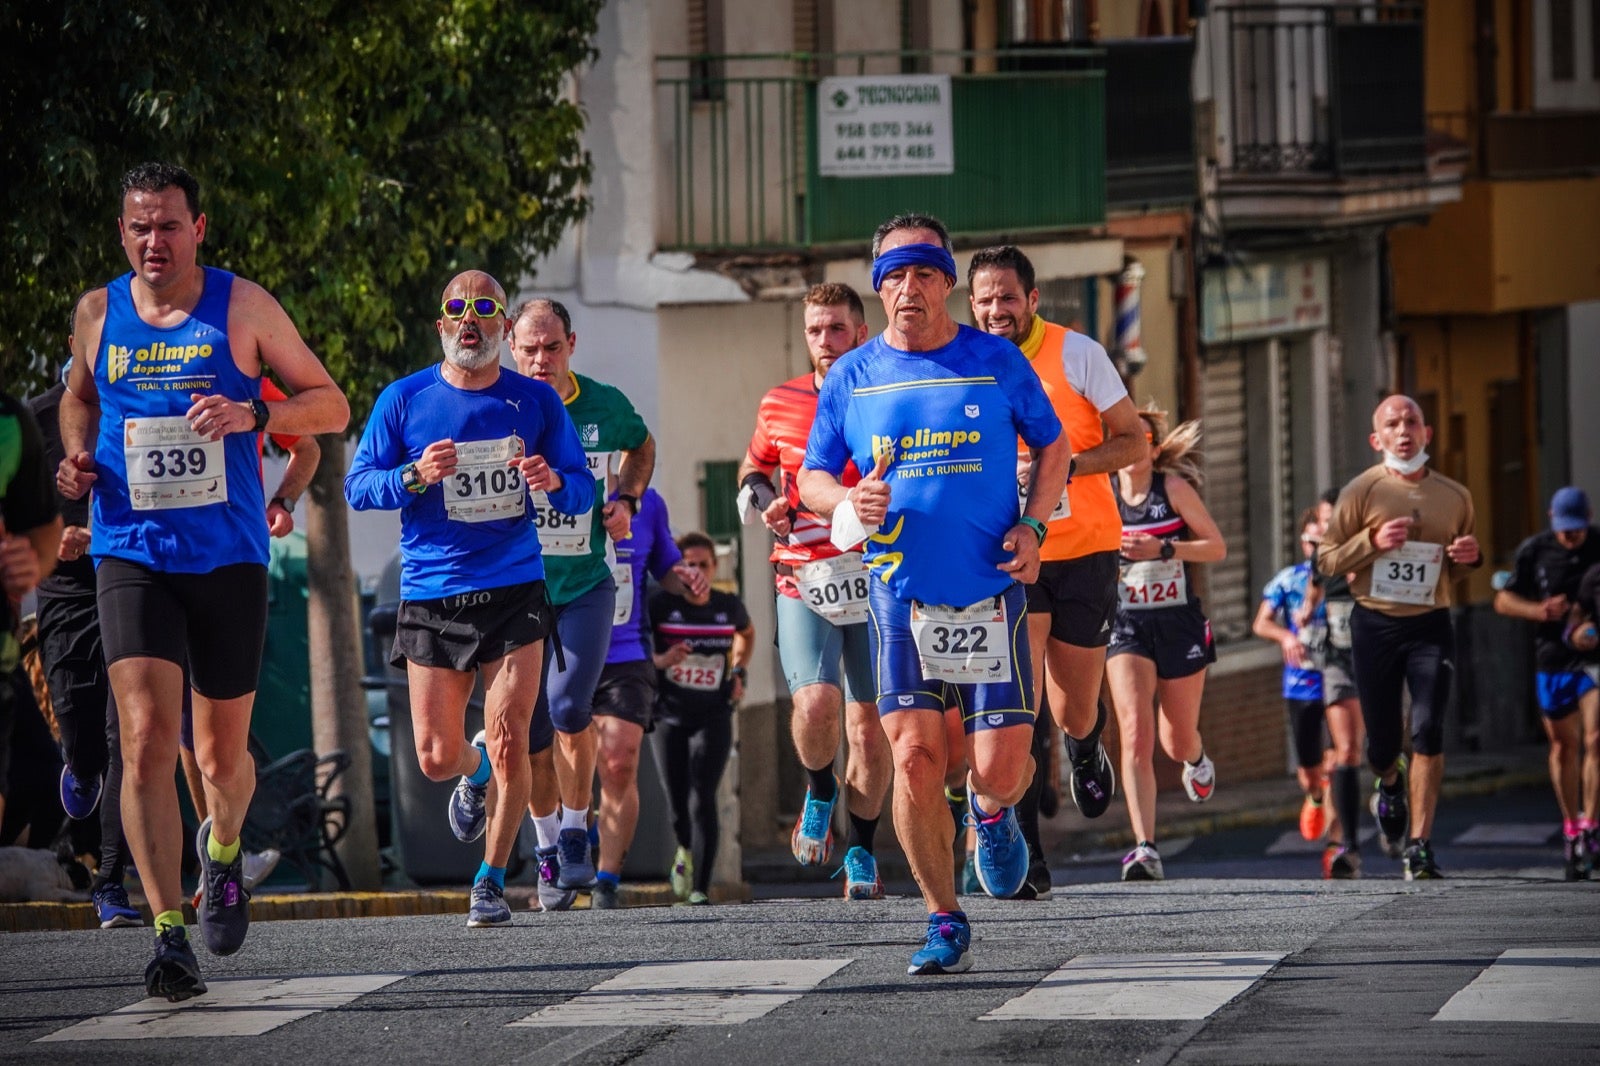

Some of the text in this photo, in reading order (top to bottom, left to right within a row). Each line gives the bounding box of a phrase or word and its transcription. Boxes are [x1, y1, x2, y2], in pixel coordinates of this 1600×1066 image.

[135, 341, 213, 364] olimpo
[132, 363, 182, 375] deportes
[136, 379, 212, 391] TRAIL & RUNNING
[900, 428, 981, 449] olimpo
[147, 447, 207, 478] 339
[900, 449, 950, 462] deportes
[455, 466, 521, 498] 3103
[897, 463, 983, 480] TRAIL & RUNNING
[535, 507, 577, 529] 584
[1388, 561, 1427, 583] 331
[808, 577, 869, 606] 3018
[1126, 581, 1179, 604] 2124
[932, 625, 988, 654] 322
[672, 665, 716, 686] 2125
